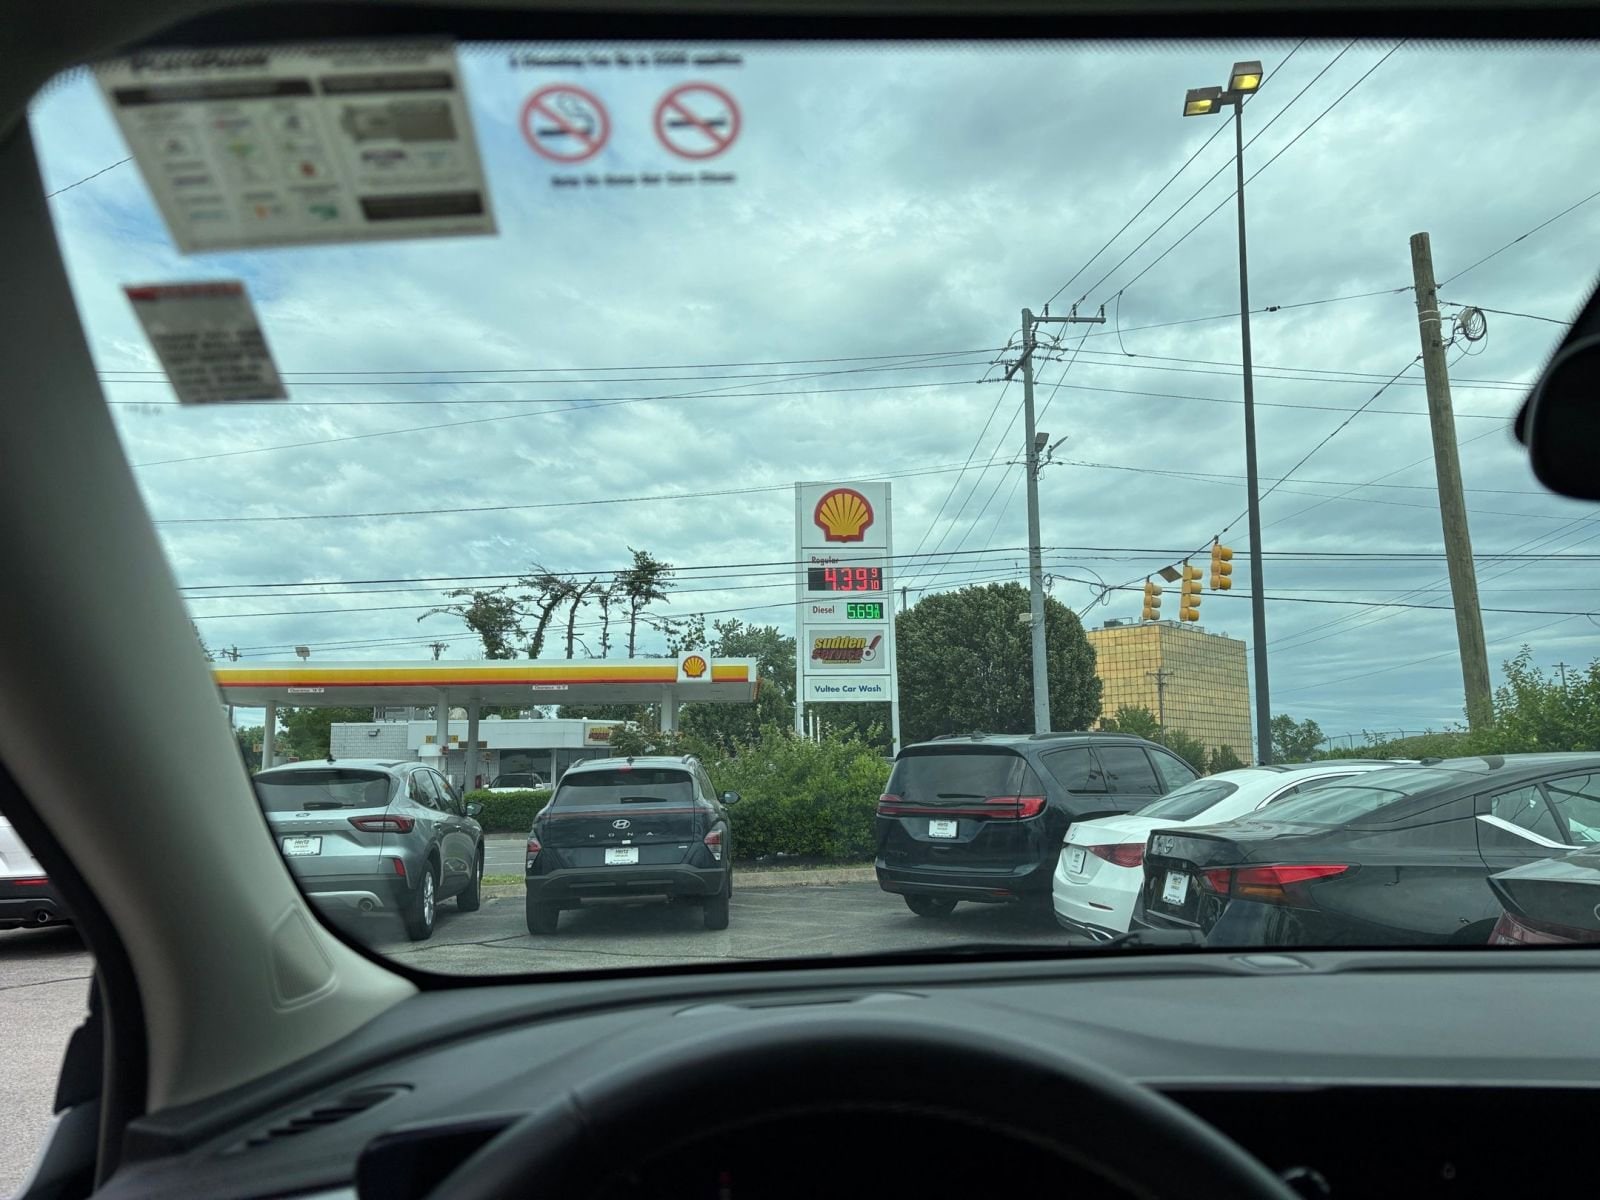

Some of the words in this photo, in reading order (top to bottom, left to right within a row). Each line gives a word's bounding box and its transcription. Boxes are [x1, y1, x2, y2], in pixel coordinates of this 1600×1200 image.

[812, 606, 835, 614] Diesel
[815, 636, 866, 649] sudden
[814, 684, 840, 693] Vultee
[842, 684, 857, 693] Car
[858, 684, 882, 693] Wash
